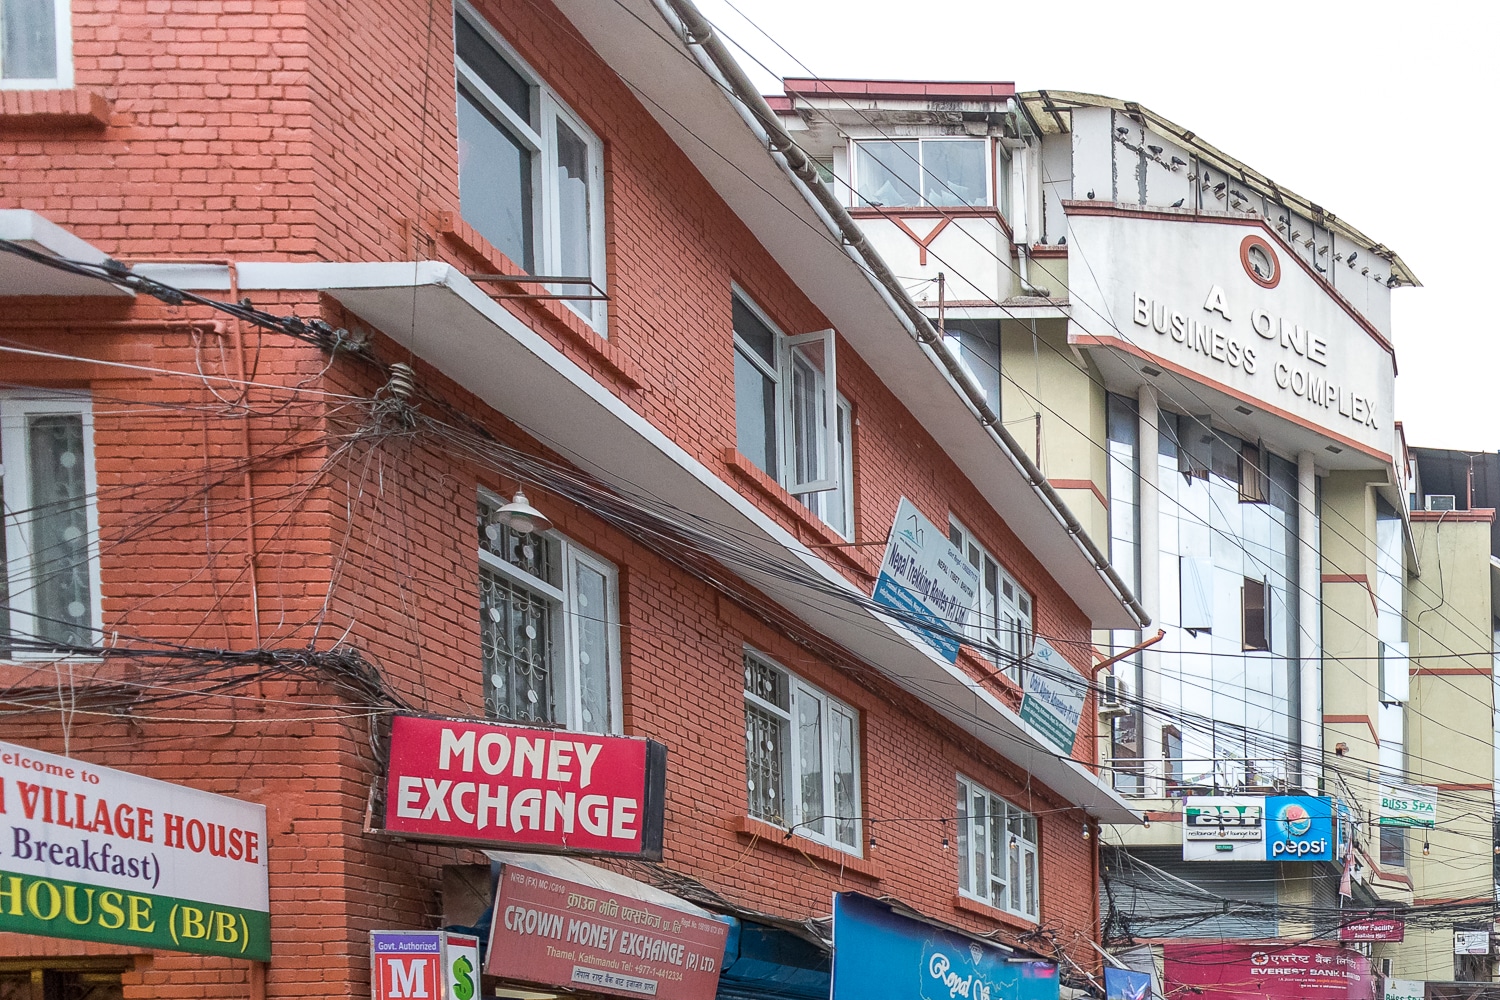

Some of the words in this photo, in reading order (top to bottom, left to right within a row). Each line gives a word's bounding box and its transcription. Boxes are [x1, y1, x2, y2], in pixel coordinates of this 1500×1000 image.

[1204, 284, 1232, 322] A
[1250, 308, 1327, 367] ONE
[1133, 291, 1257, 374] BUSINESS
[1274, 359, 1379, 430] COMPLEX
[888, 542, 908, 577] Nepal
[906, 557, 931, 602] Trekking
[929, 578, 947, 613] Routes
[1, 752, 75, 779] elcome
[81, 769, 100, 785] to
[437, 727, 604, 789] MONEY
[16, 780, 154, 844] VILLAGE
[163, 812, 259, 865] HOUSE
[396, 775, 639, 841] EXCHANGE
[11, 826, 160, 889] Breakfast)
[510, 872, 525, 885] NRB
[1272, 838, 1327, 857] pepsi
[0, 875, 156, 933] HOUSE
[169, 902, 250, 953] (B/B)
[504, 905, 564, 940] CROWN
[566, 918, 617, 953] MONEY
[619, 931, 684, 966] EXCHANGE
[700, 955, 716, 974] LTD.
[1370, 924, 1395, 933] Facility
[377, 940, 396, 952] Govt.
[398, 938, 437, 954] Authorized
[546, 946, 576, 963] Thamel,
[578, 949, 620, 970] Kathmandu
[621, 960, 633, 973] Tel:
[929, 952, 973, 999] Royal
[1310, 969, 1340, 977] BANK
